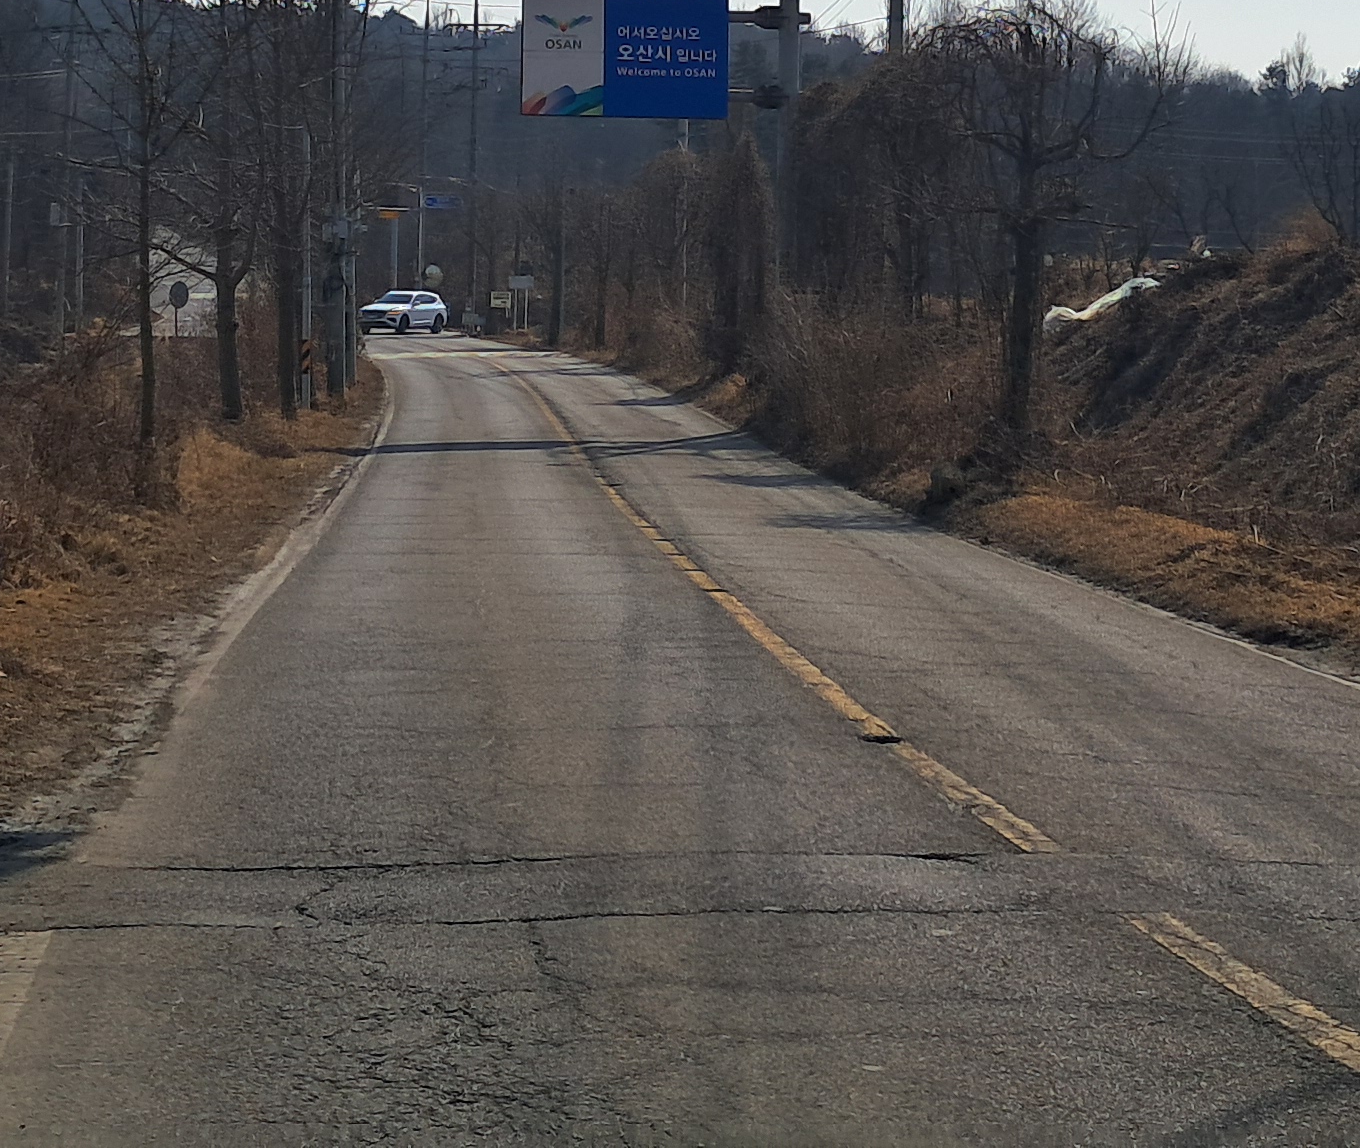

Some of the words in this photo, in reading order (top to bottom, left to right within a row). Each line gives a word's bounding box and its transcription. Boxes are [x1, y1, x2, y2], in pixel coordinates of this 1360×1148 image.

[617, 26, 701, 40] 어서오십시오
[545, 39, 582, 50] OSAN
[617, 44, 671, 63] 오산시
[676, 49, 717, 63] 입니다
[616, 67, 667, 77] Welcome
[670, 69, 681, 77] to
[684, 68, 716, 78] OSAN
